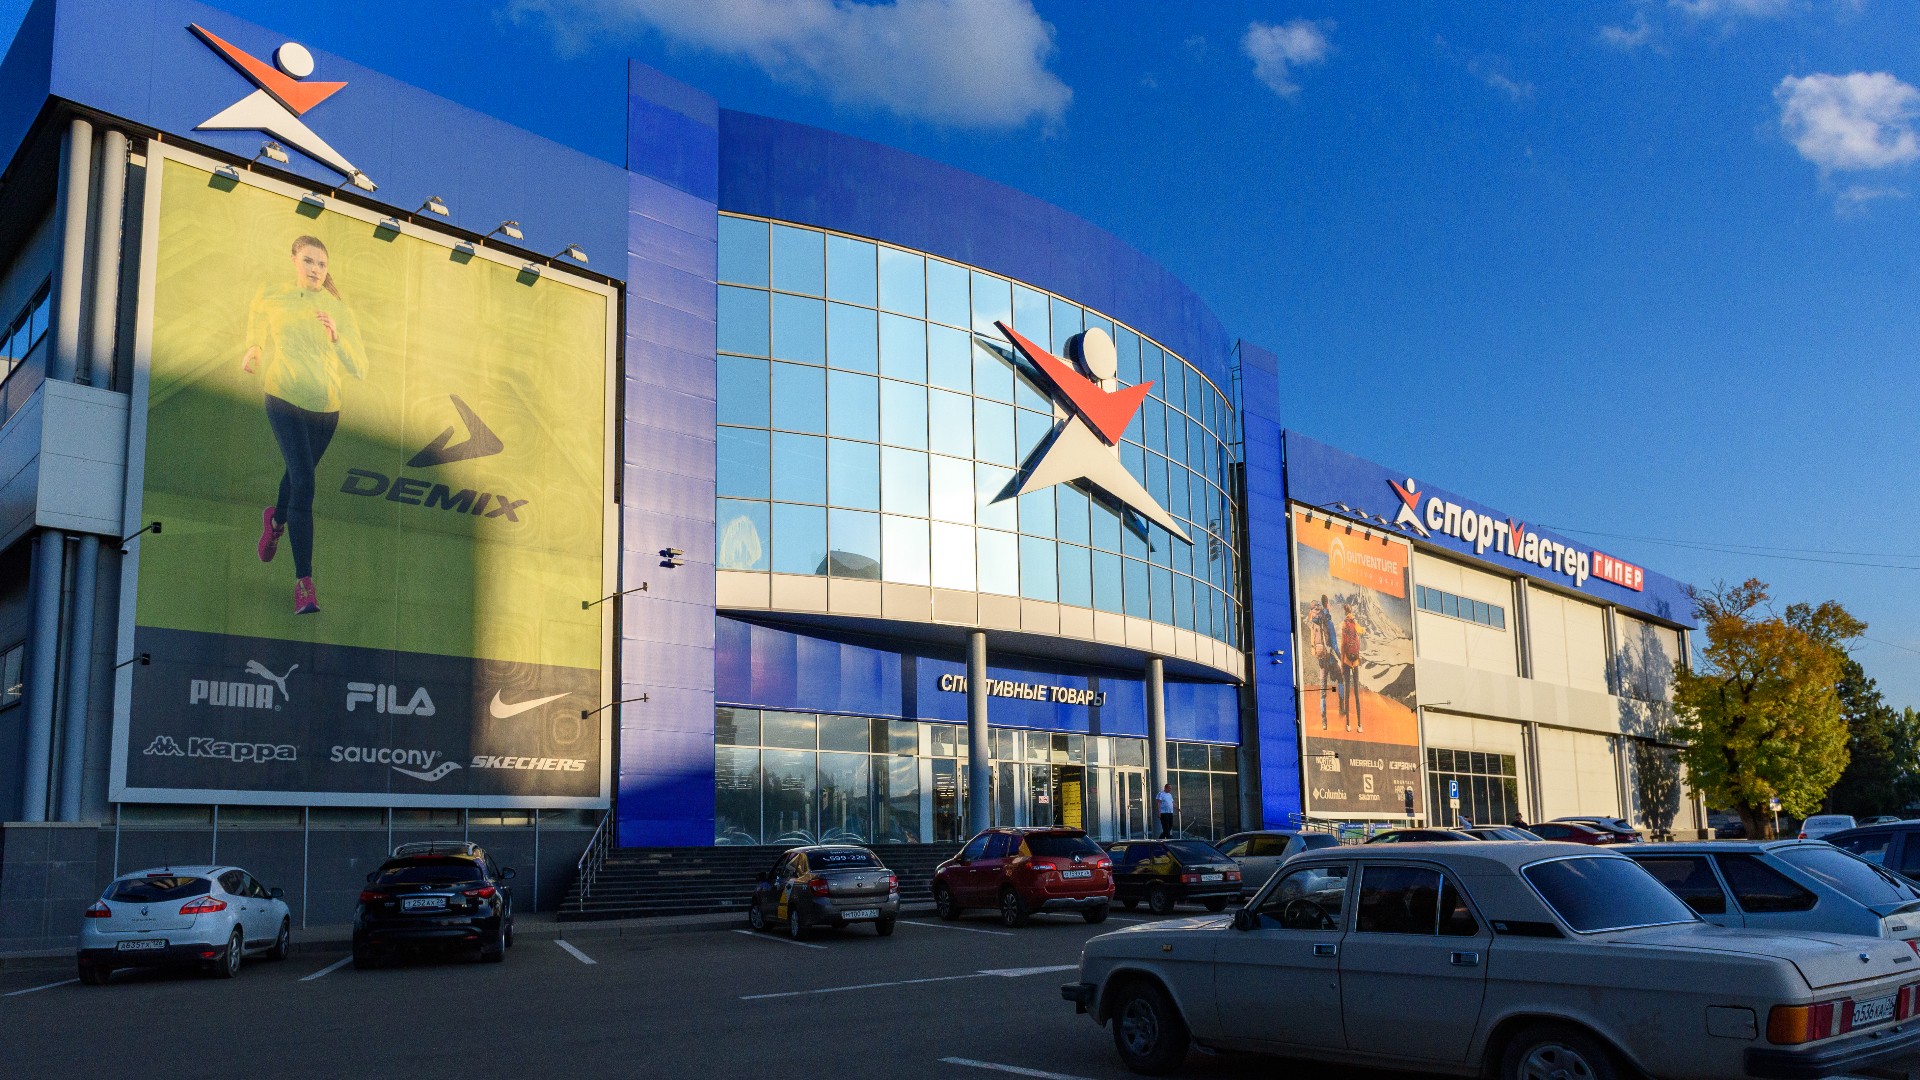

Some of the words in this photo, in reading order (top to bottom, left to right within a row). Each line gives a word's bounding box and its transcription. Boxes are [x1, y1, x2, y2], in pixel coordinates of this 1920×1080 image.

[340, 468, 529, 522] DEMIX
[1347, 550, 1398, 575] OUTVENTURE
[1348, 568, 1373, 579] active
[1594, 554, 1643, 587] ГИПЕР
[190, 679, 274, 709] PUMA
[346, 682, 436, 717] FILA
[940, 674, 1047, 701] СПТИВНЫЕ
[1050, 686, 1107, 706] ТОВАРЫ
[188, 737, 298, 763] Kappa
[330, 745, 437, 769] saucony
[470, 755, 587, 771] SKECHERS
[1349, 758, 1379, 768] MERRELL
[1319, 788, 1347, 799] Columbia
[120, 940, 151, 951] А635ТХ
